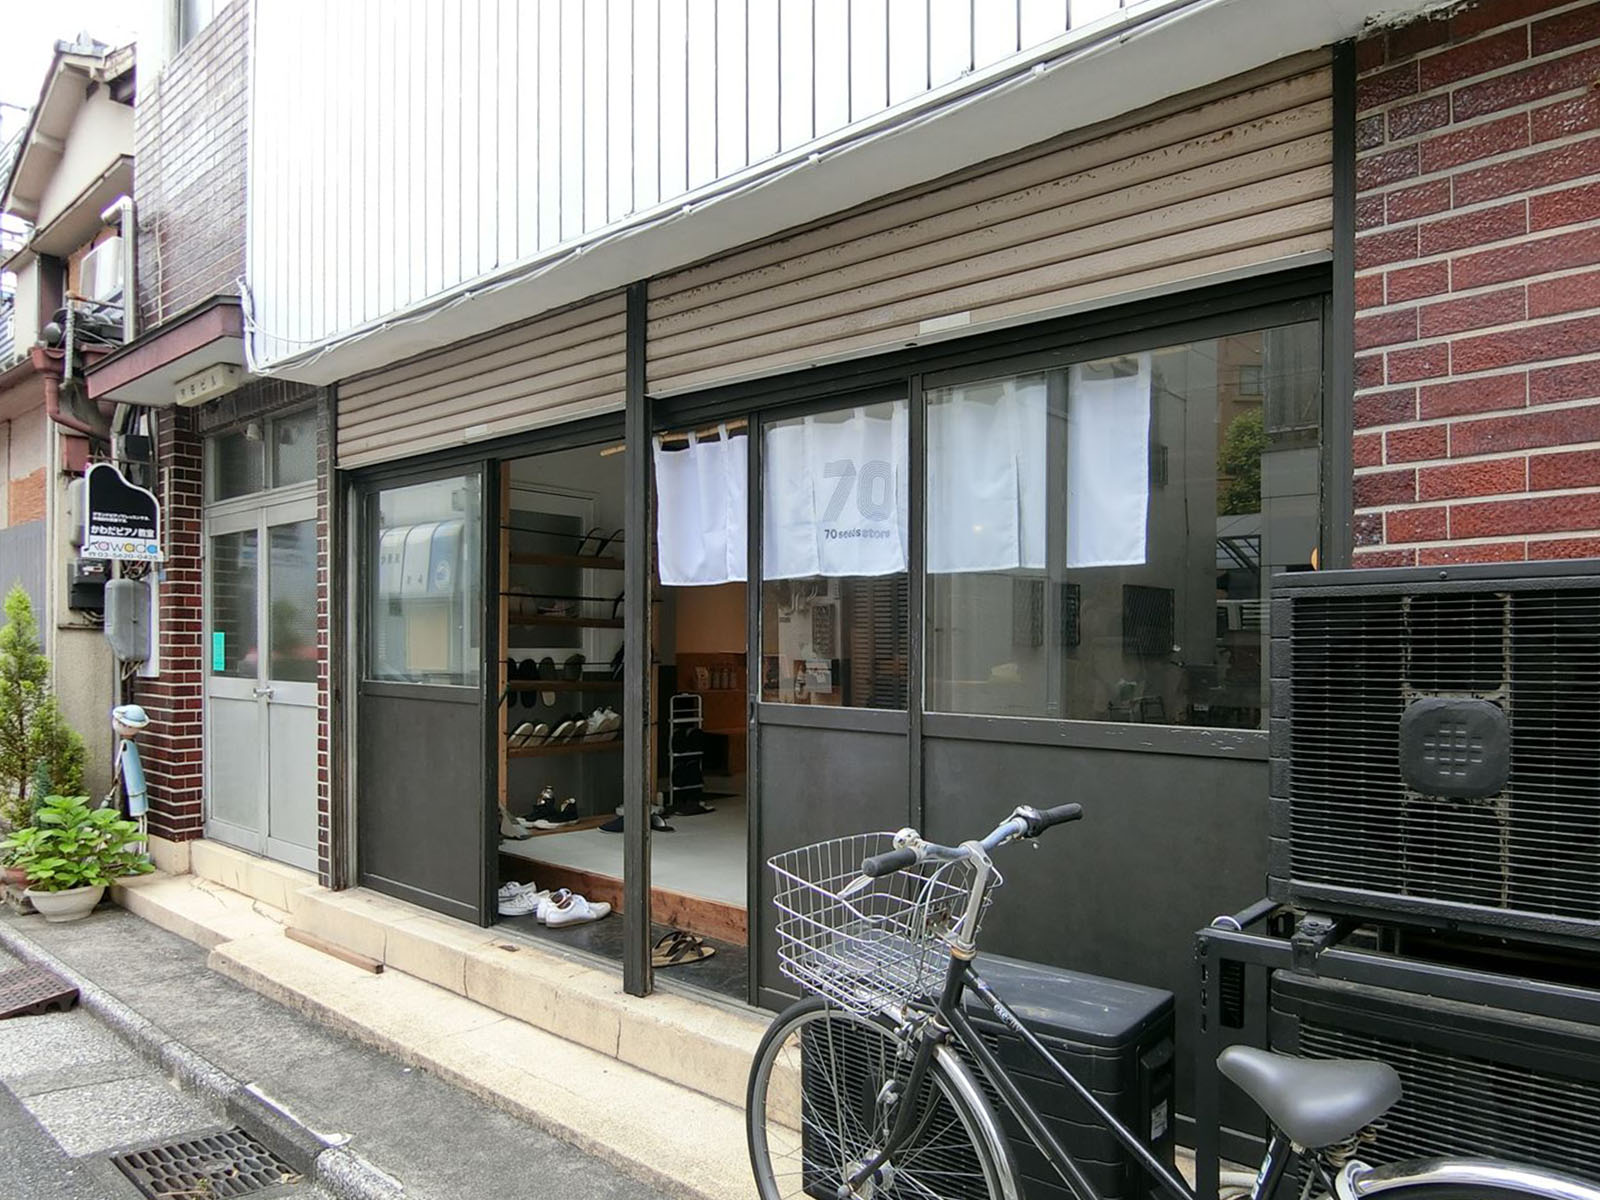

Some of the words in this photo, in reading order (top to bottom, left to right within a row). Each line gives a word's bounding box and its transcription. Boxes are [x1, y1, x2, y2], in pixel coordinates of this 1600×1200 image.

[822, 459, 892, 522] 70
[91, 526, 154, 537] かわだピアノ教室
[824, 529, 837, 539] 70
